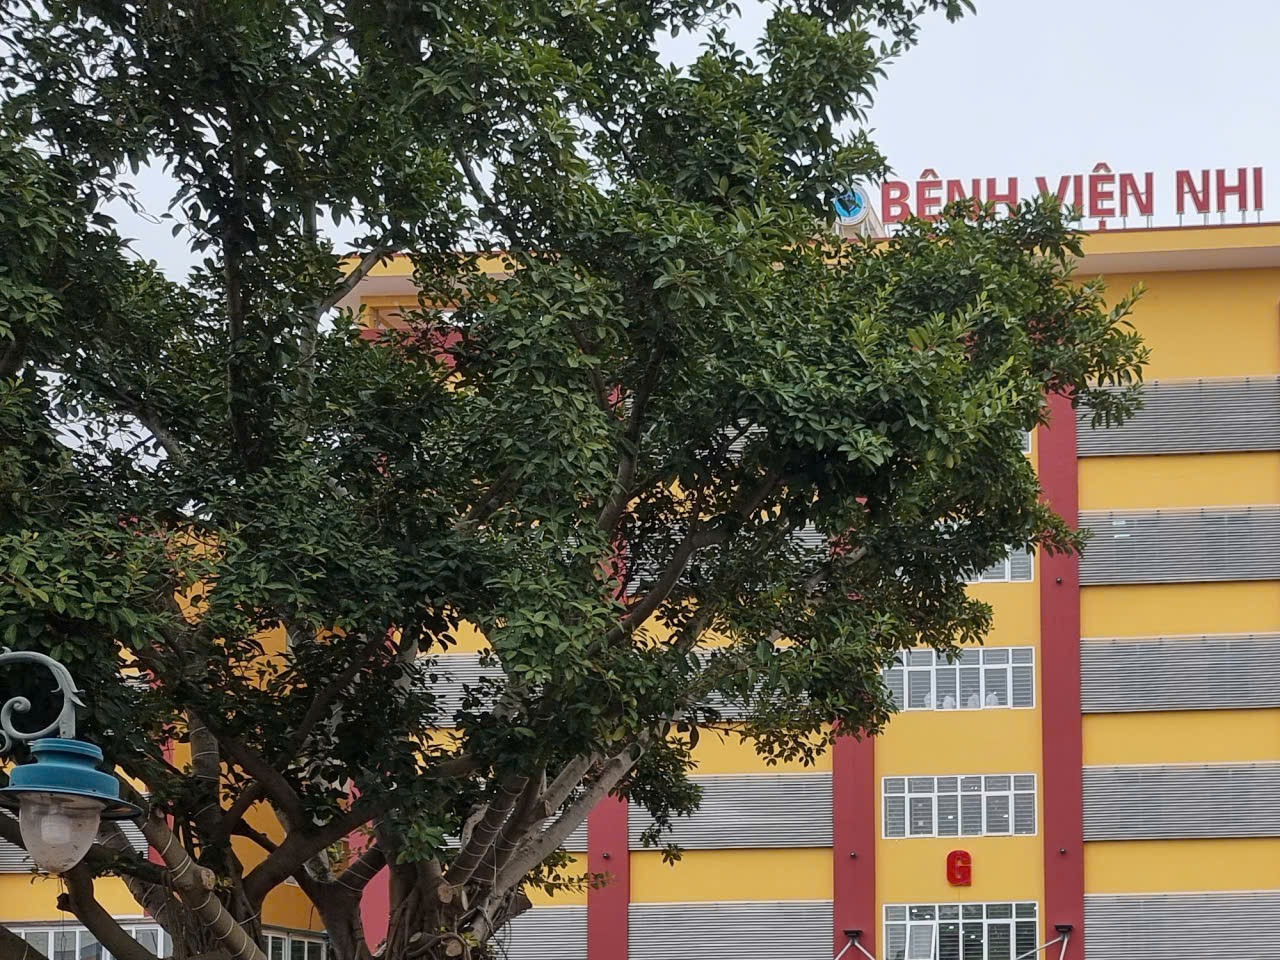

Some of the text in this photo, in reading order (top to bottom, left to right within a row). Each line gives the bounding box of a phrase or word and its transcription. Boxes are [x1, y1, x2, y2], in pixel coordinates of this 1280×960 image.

[1036, 162, 1154, 231] VIỆN
[1176, 167, 1264, 214] NHI
[946, 850, 972, 887] G
